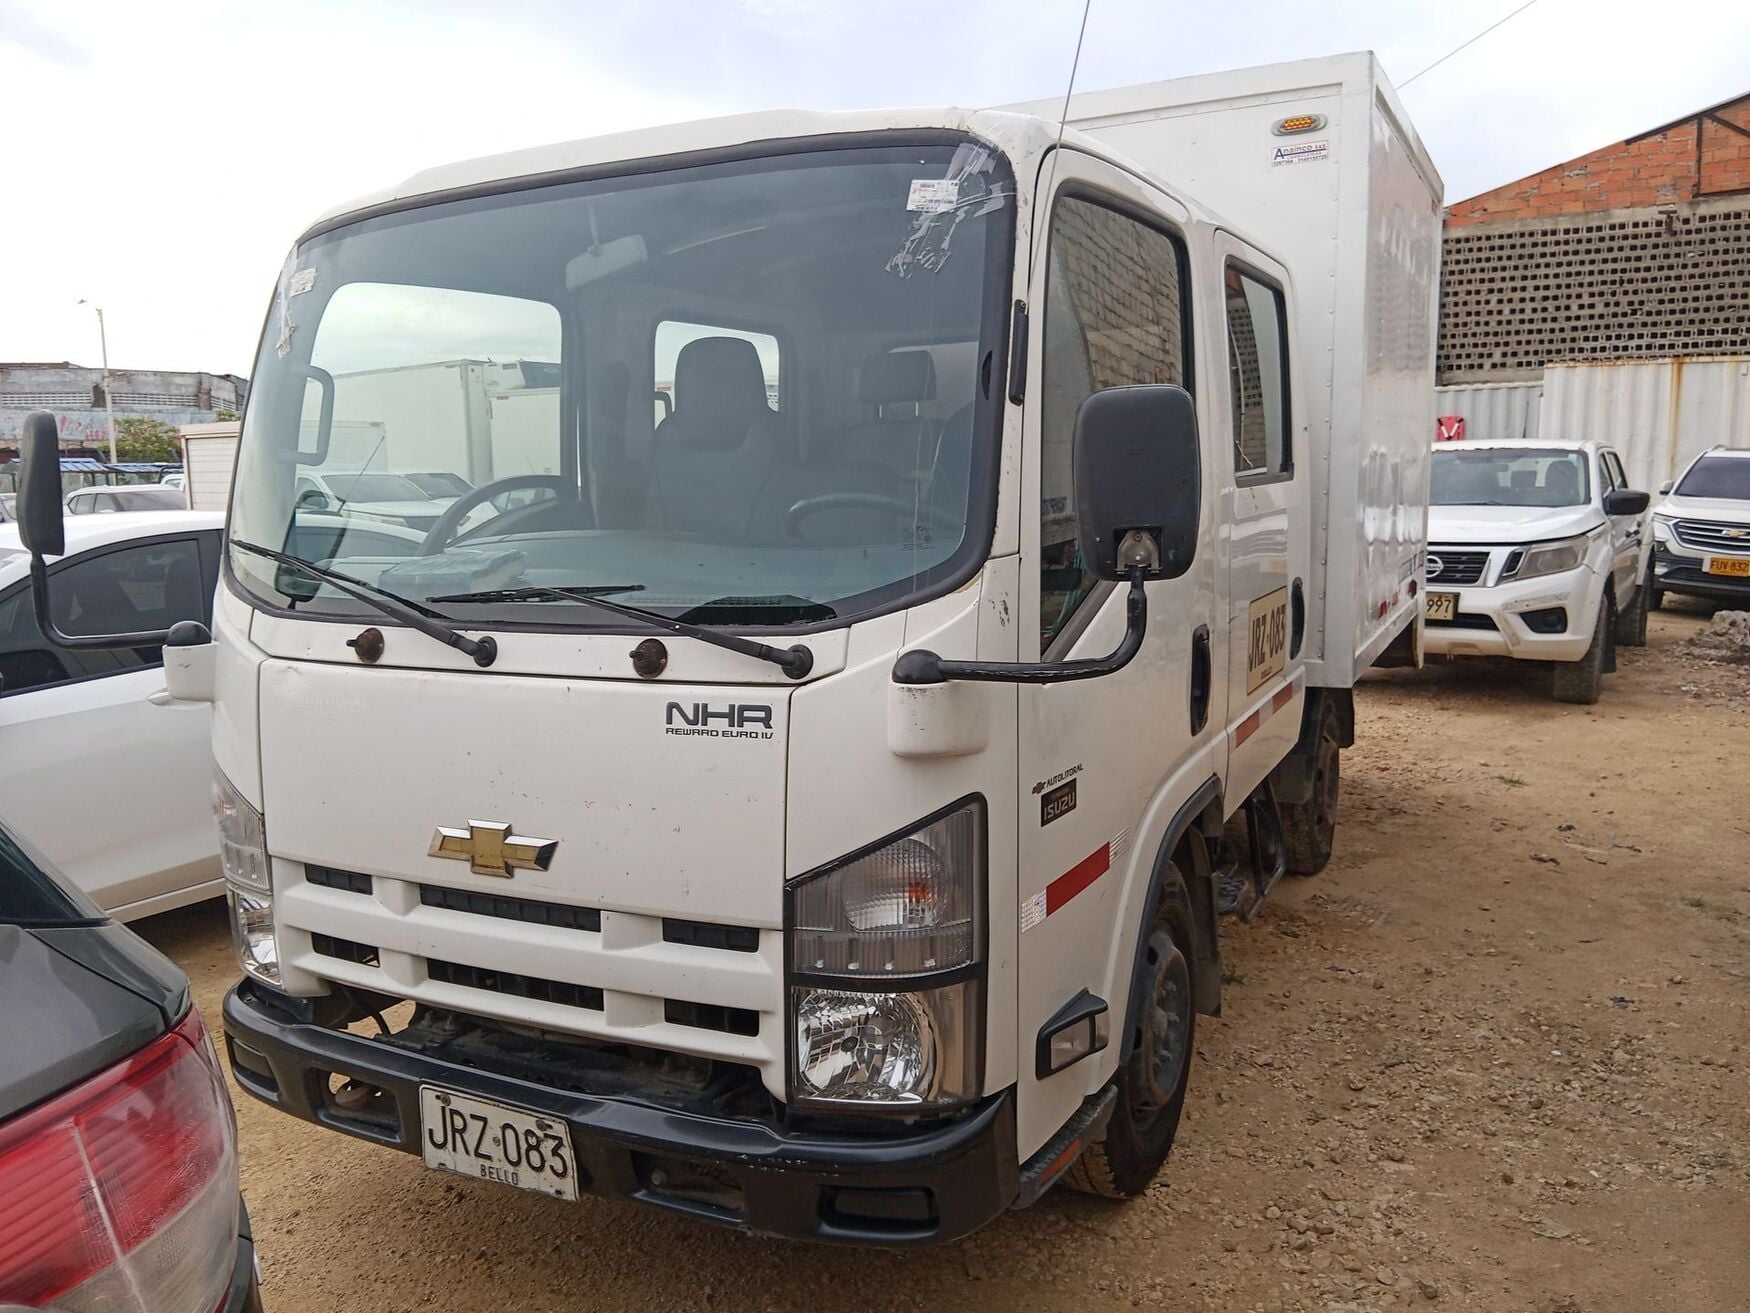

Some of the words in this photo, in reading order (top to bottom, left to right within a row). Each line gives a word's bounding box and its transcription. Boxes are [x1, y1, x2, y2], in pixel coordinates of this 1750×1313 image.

[665, 701, 774, 730] NHR
[665, 727, 720, 738] REWARD
[721, 730, 760, 740] EURO
[1046, 763, 1084, 788] AUTOLITORAL
[1043, 792, 1076, 821] ISUZU
[480, 1163, 519, 1186] BELLO
